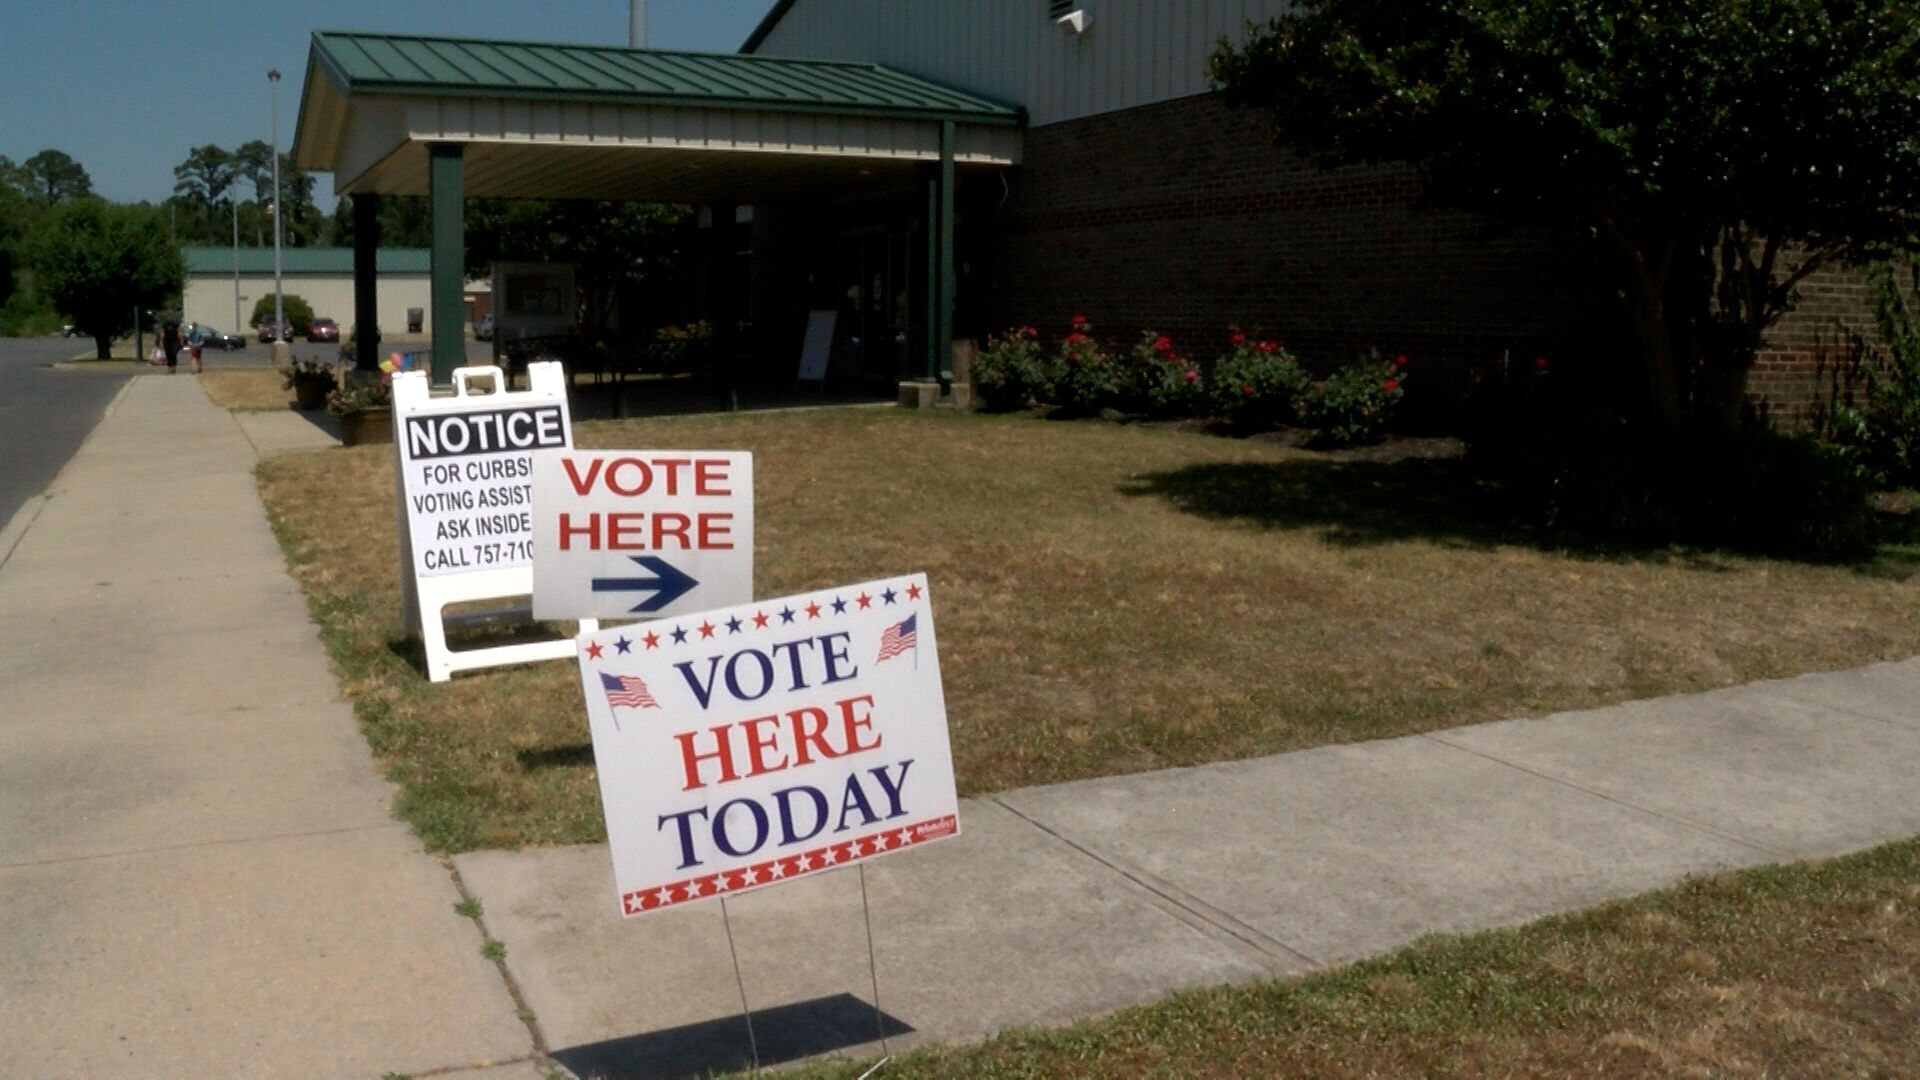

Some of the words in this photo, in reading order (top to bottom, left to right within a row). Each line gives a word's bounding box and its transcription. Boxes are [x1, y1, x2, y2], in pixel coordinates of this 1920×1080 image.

[408, 408, 563, 456] NOTICE
[422, 463, 462, 486] FOR
[561, 457, 732, 497] VOTE
[413, 489, 474, 514] VOTING
[478, 484, 532, 508] ASSIST
[436, 517, 472, 541] ASK
[475, 512, 531, 536] INSIDE
[558, 512, 734, 551] HERE
[424, 547, 471, 571] CALL
[673, 631, 858, 710] VOTE
[673, 694, 882, 792] HERE
[657, 759, 914, 870] TODAY
